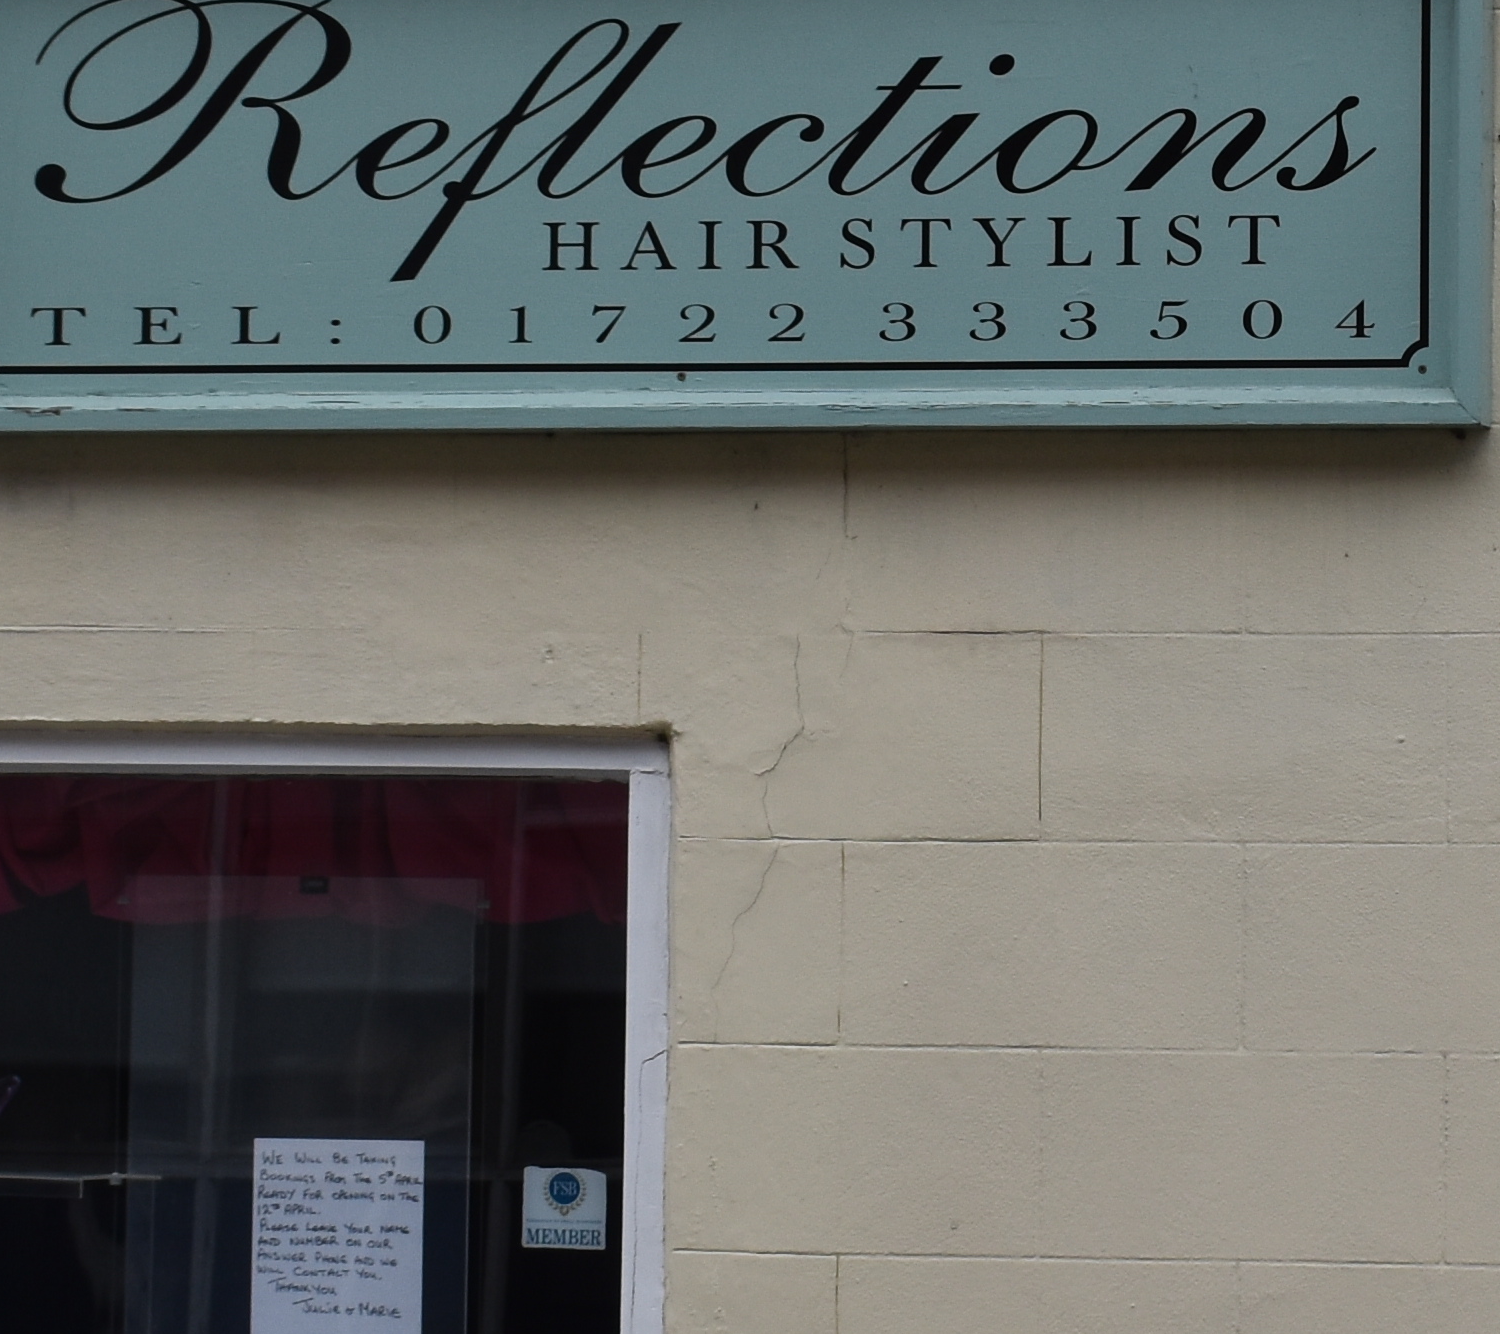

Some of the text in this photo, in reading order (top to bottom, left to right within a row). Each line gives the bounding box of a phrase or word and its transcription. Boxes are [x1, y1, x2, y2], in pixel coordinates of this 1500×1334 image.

[30, 299, 1376, 346] TEL: 01722 333504
[553, 1180, 577, 1196] FSB
[526, 1228, 602, 1247] MEMBER
